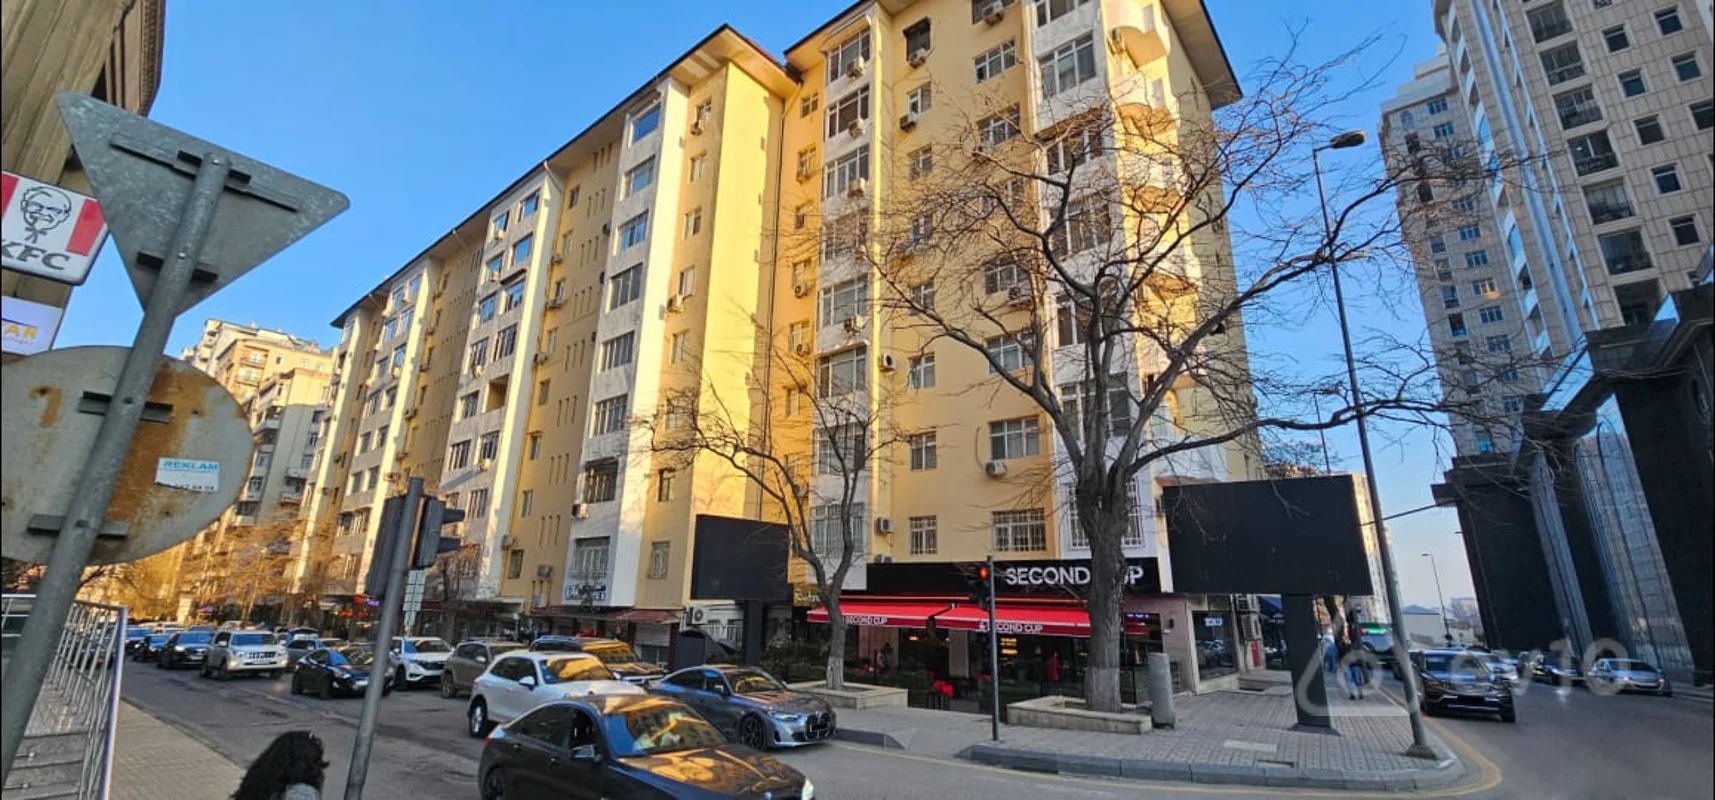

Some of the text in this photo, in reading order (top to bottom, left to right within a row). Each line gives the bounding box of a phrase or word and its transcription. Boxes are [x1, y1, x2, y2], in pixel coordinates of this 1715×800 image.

[3, 324, 38, 339] AR
[163, 460, 218, 471] REKLAM
[1005, 566, 1091, 585] SECOND
[1024, 622, 1044, 634] CUP
